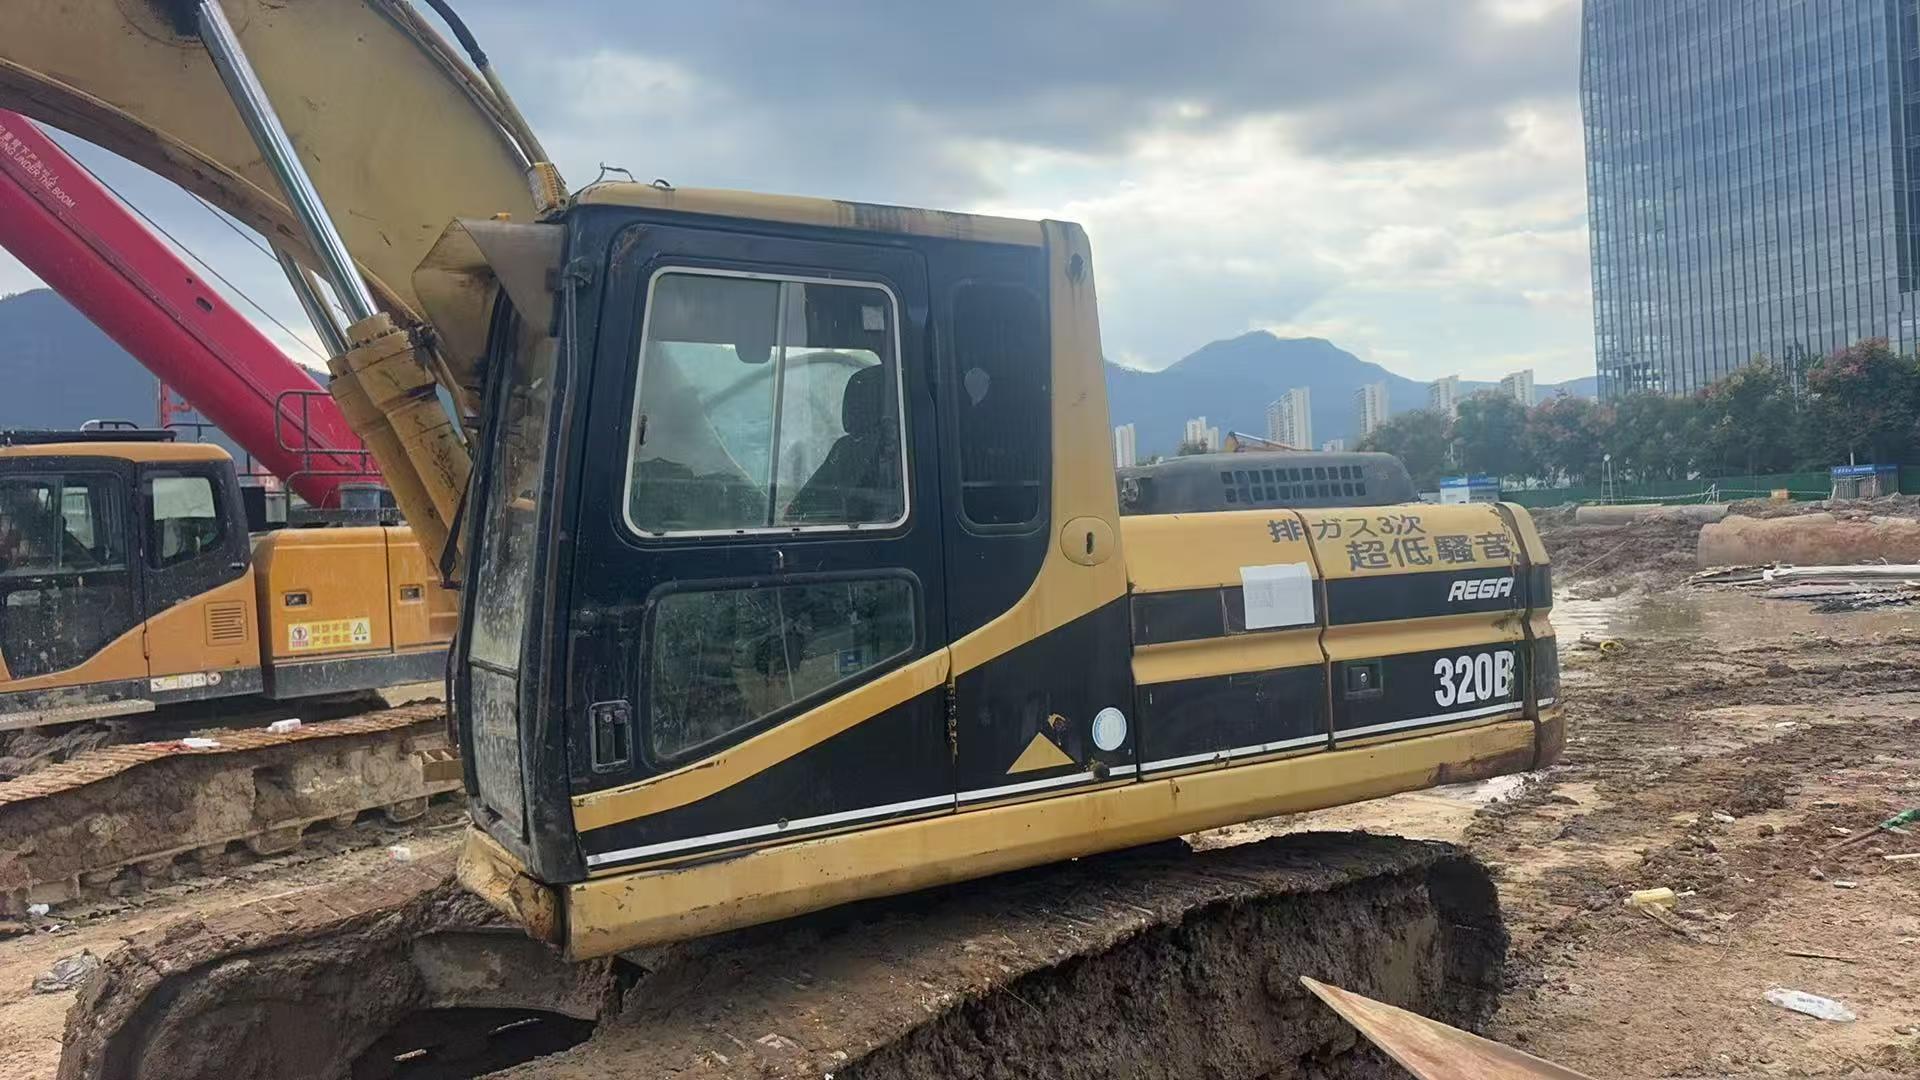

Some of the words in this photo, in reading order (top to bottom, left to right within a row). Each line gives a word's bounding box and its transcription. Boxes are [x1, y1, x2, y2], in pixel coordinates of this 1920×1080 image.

[14, 152, 40, 177] UNDER
[40, 174, 55, 190] THE
[52, 186, 76, 208] BOOM
[1268, 514, 1426, 543] 排ガス3次
[1448, 577, 1514, 601] REGA
[1434, 650, 1514, 707] 320B
